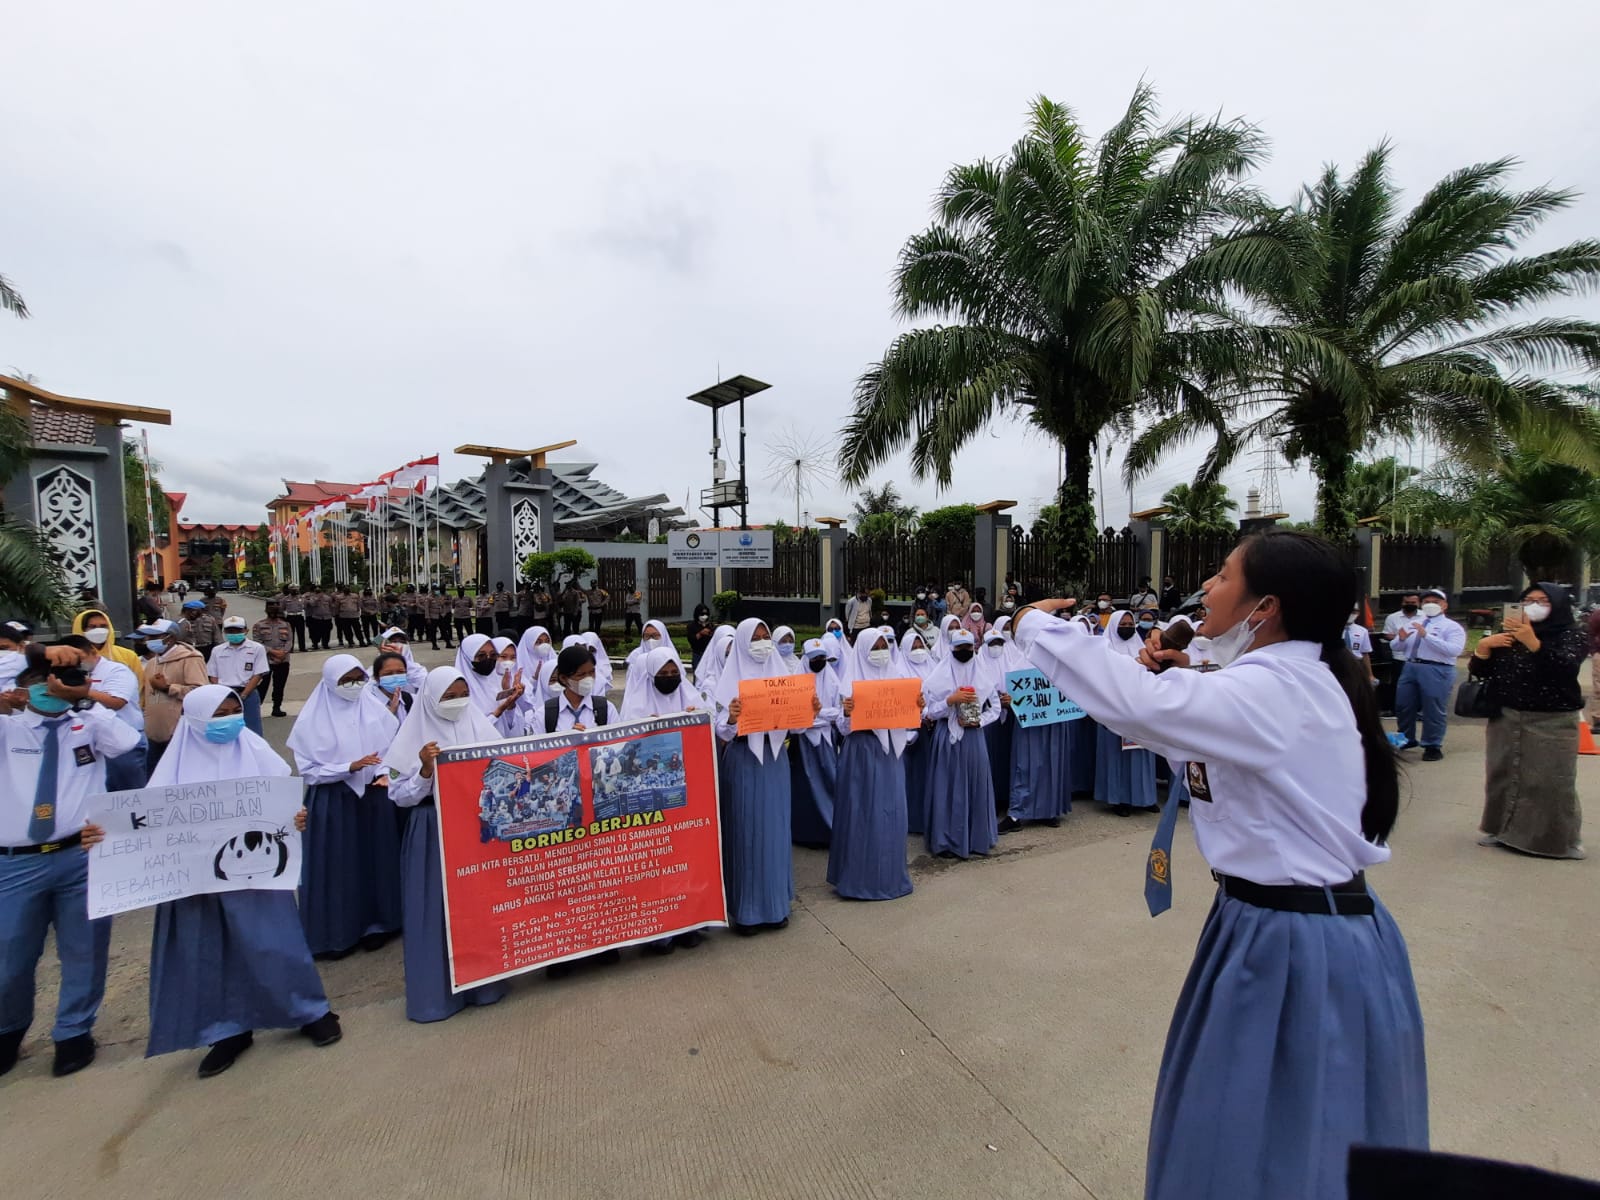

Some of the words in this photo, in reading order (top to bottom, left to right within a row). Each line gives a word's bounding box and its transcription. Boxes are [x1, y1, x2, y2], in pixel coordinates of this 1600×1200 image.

[539, 738, 571, 749] MASSA
[672, 717, 701, 726] MASSA
[104, 794, 142, 812] JIKA
[165, 784, 217, 803] BUKAN
[235, 780, 271, 796] DEMI
[130, 797, 263, 830] KEADILAN
[99, 837, 152, 858] LEBIH
[456, 864, 479, 878] MARI
[481, 859, 500, 871] KITA
[545, 841, 591, 859] MENDUDUKI
[594, 836, 615, 847] SMAN
[618, 832, 627, 842] 10
[628, 825, 672, 841] SAMARINDA
[673, 818, 703, 831] KAMPUS
[705, 817, 710, 826] A
[511, 827, 587, 853] BORNEO
[590, 810, 665, 836] BERJAYA
[144, 852, 181, 870] KAMI
[506, 873, 556, 888] SAMARINDA
[557, 860, 598, 878] SEBERANG
[600, 851, 648, 867] KALIMANTAN
[650, 845, 673, 858] TIMUR
[508, 867, 517, 877] DI
[519, 862, 545, 875] JALAN
[577, 847, 612, 861] RIFFADIN
[613, 844, 628, 854] LOA
[630, 839, 654, 852] JANAN
[656, 835, 670, 846] ILIR
[101, 868, 190, 899] REBAHAN
[492, 898, 522, 914] HARUS
[523, 891, 555, 906] ANGKAT
[557, 886, 576, 898] KAKI
[577, 881, 596, 893] DARI
[598, 877, 622, 889] TANAH
[624, 869, 660, 883] PEMPROV
[662, 863, 688, 876] KALTIM
[524, 881, 555, 895] STATUS
[556, 872, 591, 888] YAYASAN
[593, 867, 620, 880] MELATI
[511, 920, 527, 931] SK
[598, 895, 637, 910] 745/2014
[641, 893, 687, 908] Samarinda
[513, 935, 543, 948] Sekda
[513, 941, 554, 957] Putusan
[556, 936, 572, 945] MA
[514, 950, 555, 966] Putusan
[557, 945, 571, 955] PK
[591, 937, 602, 945] 72
[605, 924, 664, 942] PK/TUN/2017
